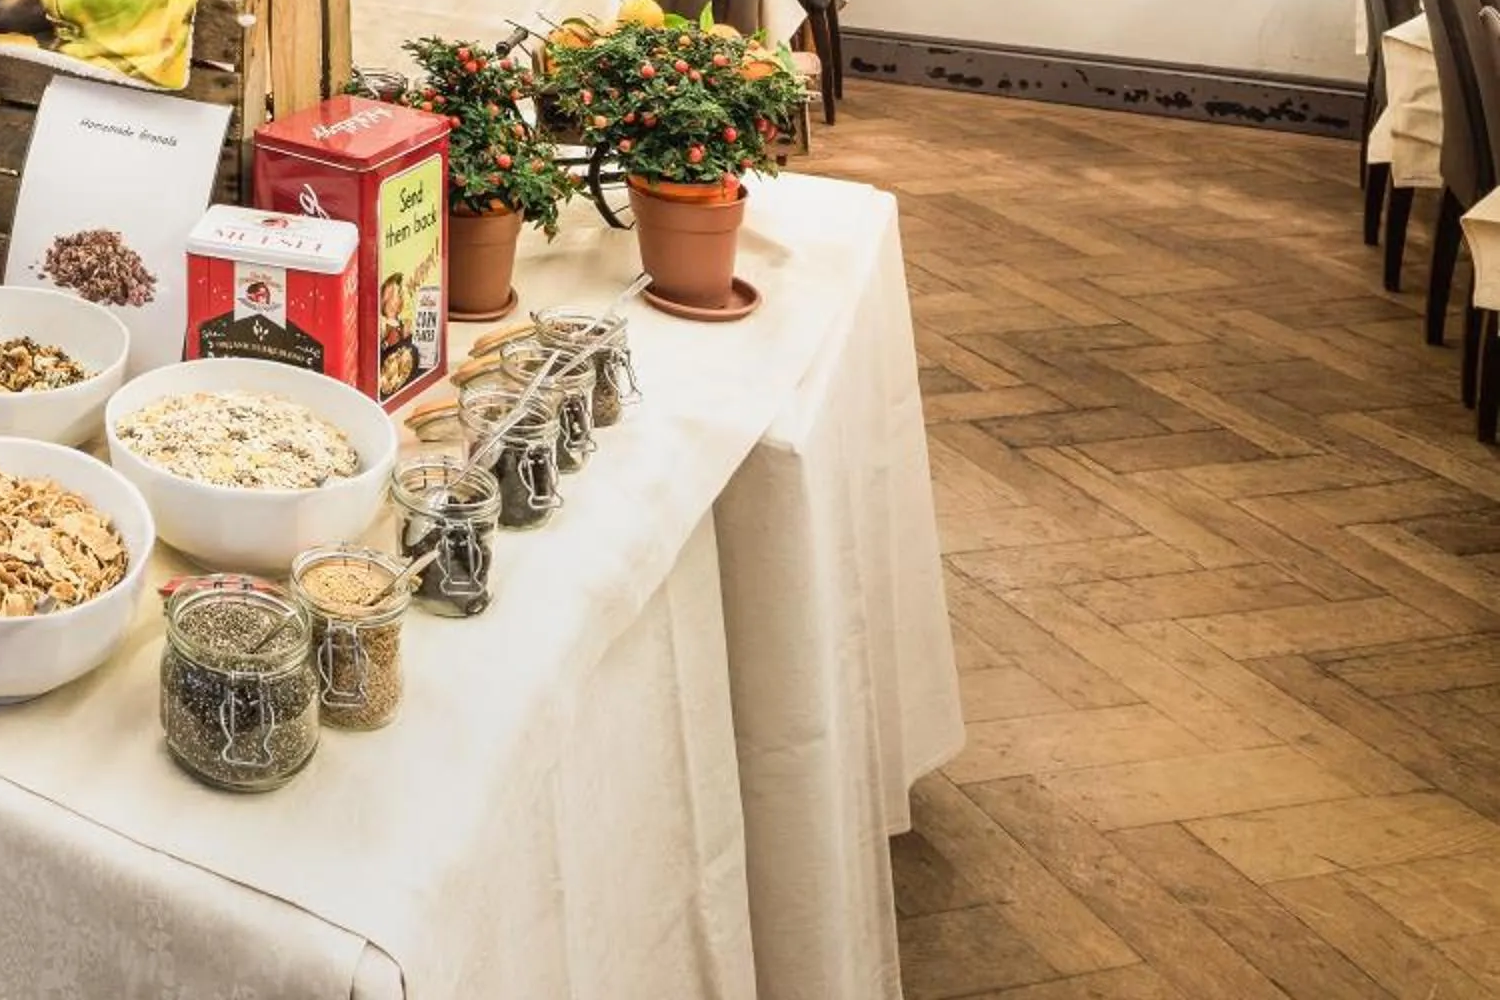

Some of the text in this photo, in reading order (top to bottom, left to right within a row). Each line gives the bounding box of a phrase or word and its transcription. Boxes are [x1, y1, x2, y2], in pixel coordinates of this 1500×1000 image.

[400, 180, 423, 212] Send
[385, 203, 437, 249] them back
